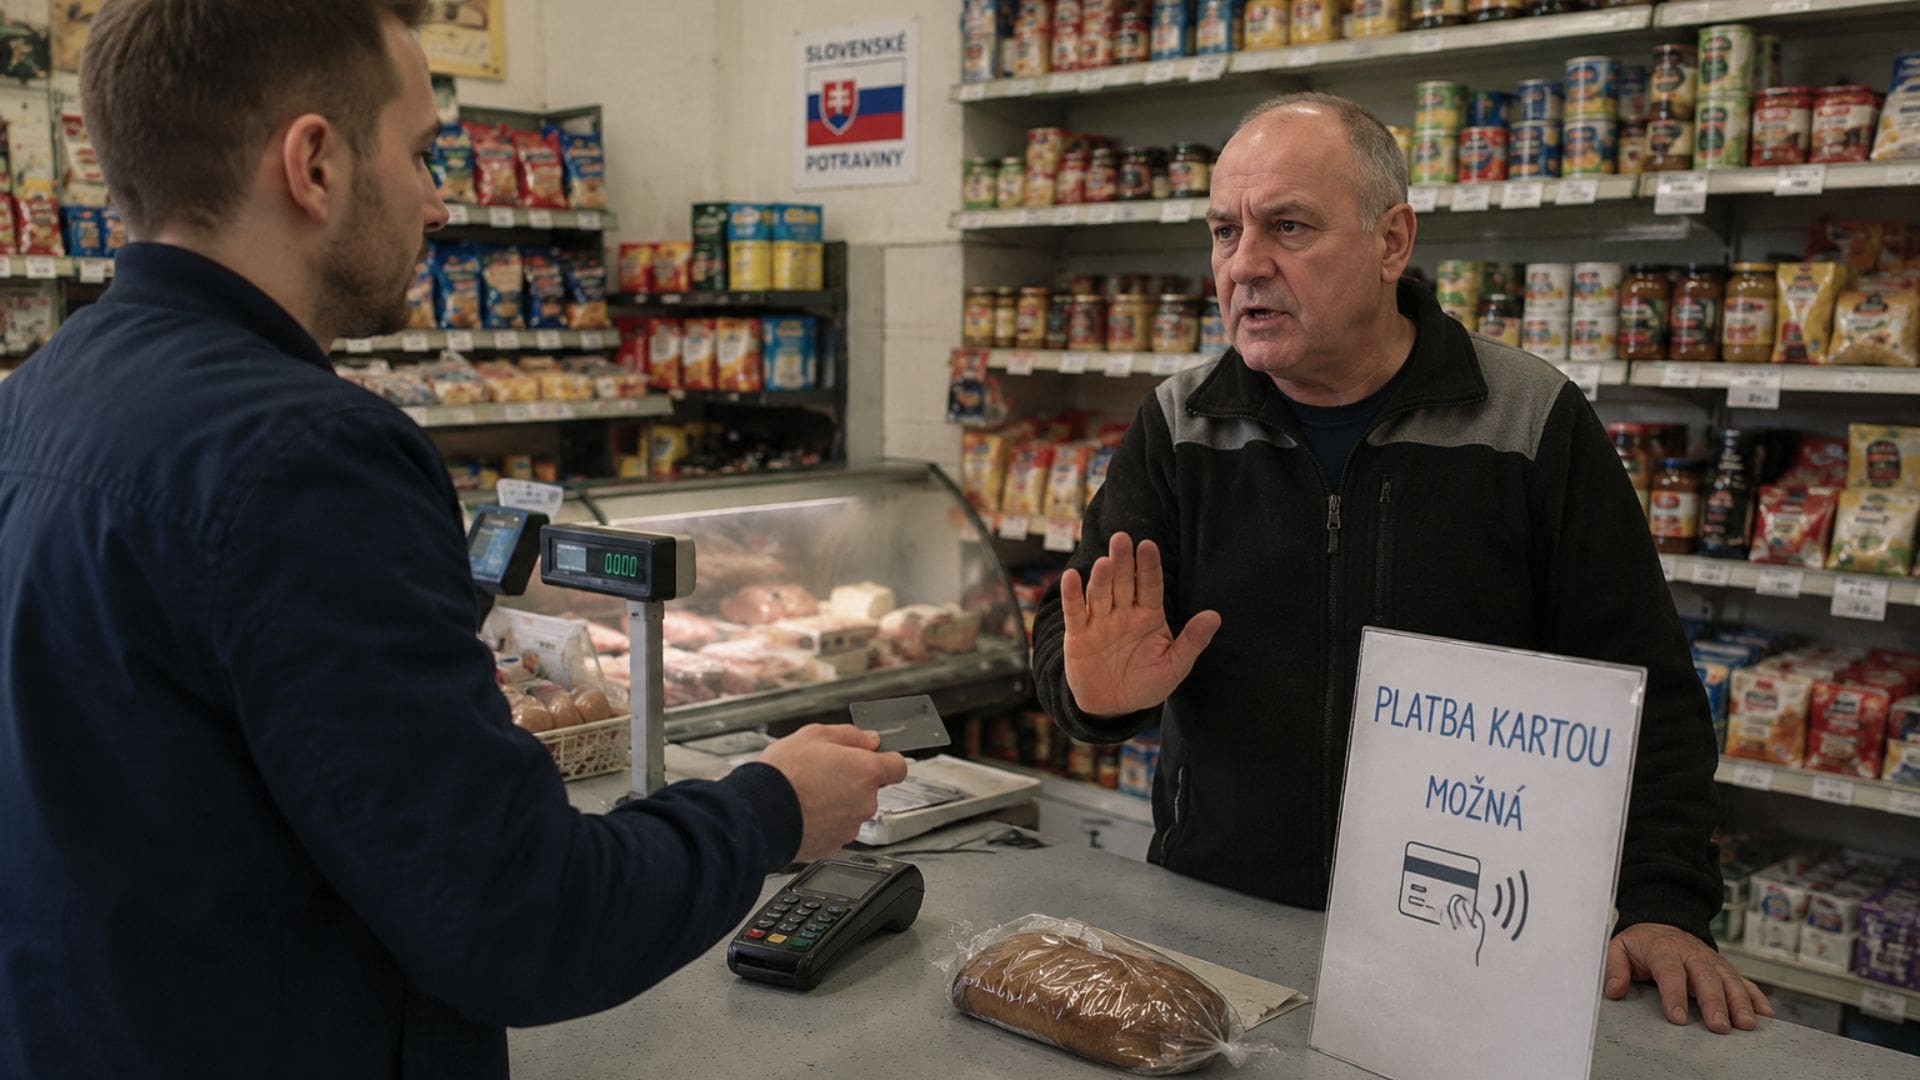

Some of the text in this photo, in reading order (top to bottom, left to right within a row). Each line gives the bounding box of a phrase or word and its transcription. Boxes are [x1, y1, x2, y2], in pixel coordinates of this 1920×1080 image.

[805, 32, 906, 63] SLOVENSKÉ
[805, 150, 904, 172] POTRAVINY
[1374, 685, 1612, 768] PLATBA KARTOU
[1425, 774, 1526, 831] MOŽNÁ
